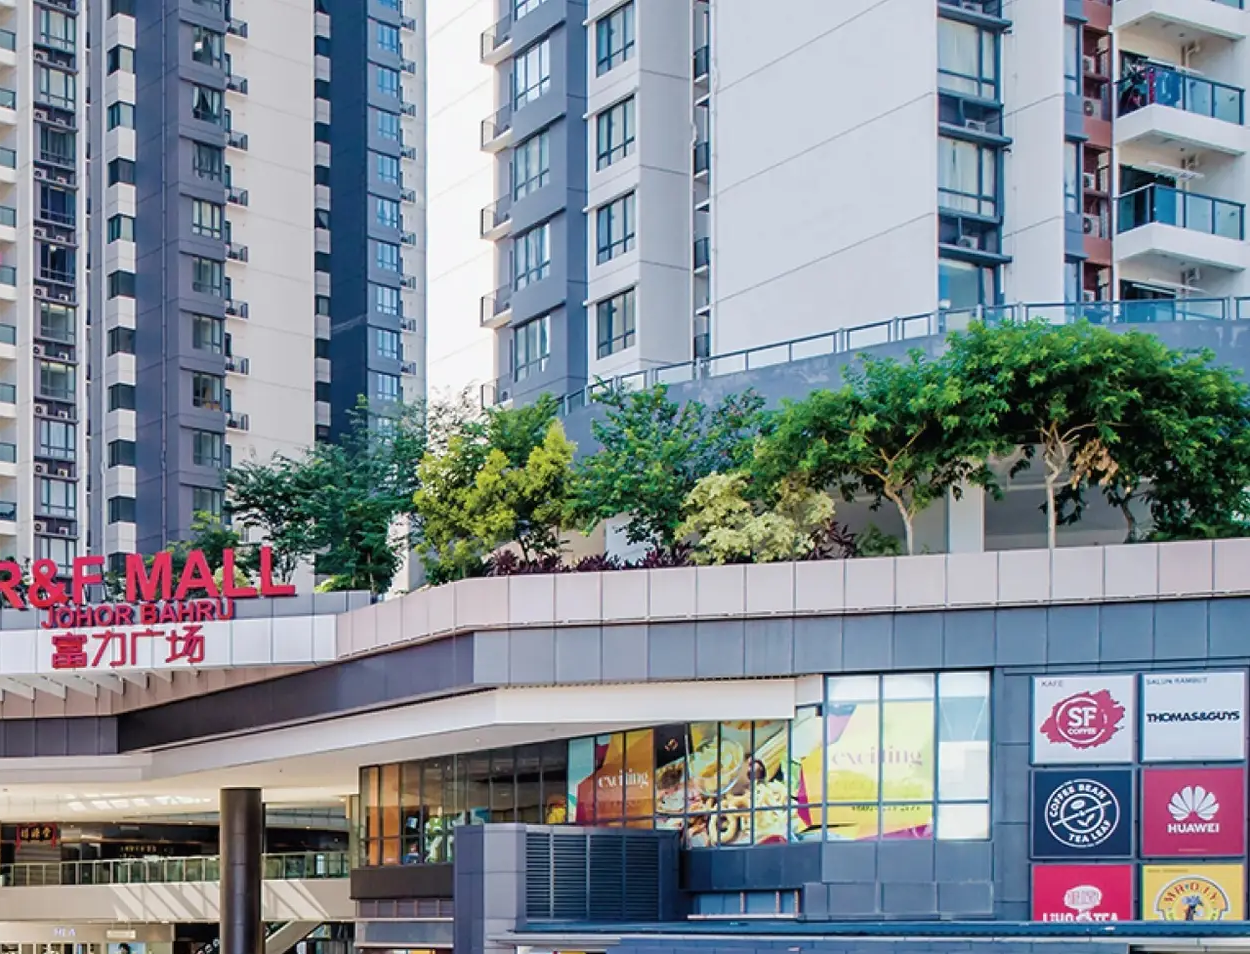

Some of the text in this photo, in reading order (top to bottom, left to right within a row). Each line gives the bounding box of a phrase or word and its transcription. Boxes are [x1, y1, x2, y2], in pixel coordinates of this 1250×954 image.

[126, 546, 296, 601] MALL
[41, 598, 236, 629] JOHOR BAHRU
[51, 624, 206, 669] 富力广场
[1067, 706, 1098, 727] SF
[1146, 710, 1240, 723] THOMAS&GUYS
[1067, 727, 1097, 735] COFFEE
[832, 746, 923, 767] exciing
[597, 768, 649, 789] exciing
[1049, 783, 1107, 818] COFFEE BEAN
[1069, 833, 1090, 843] TEA
[1167, 823, 1220, 834] HUAWEI
